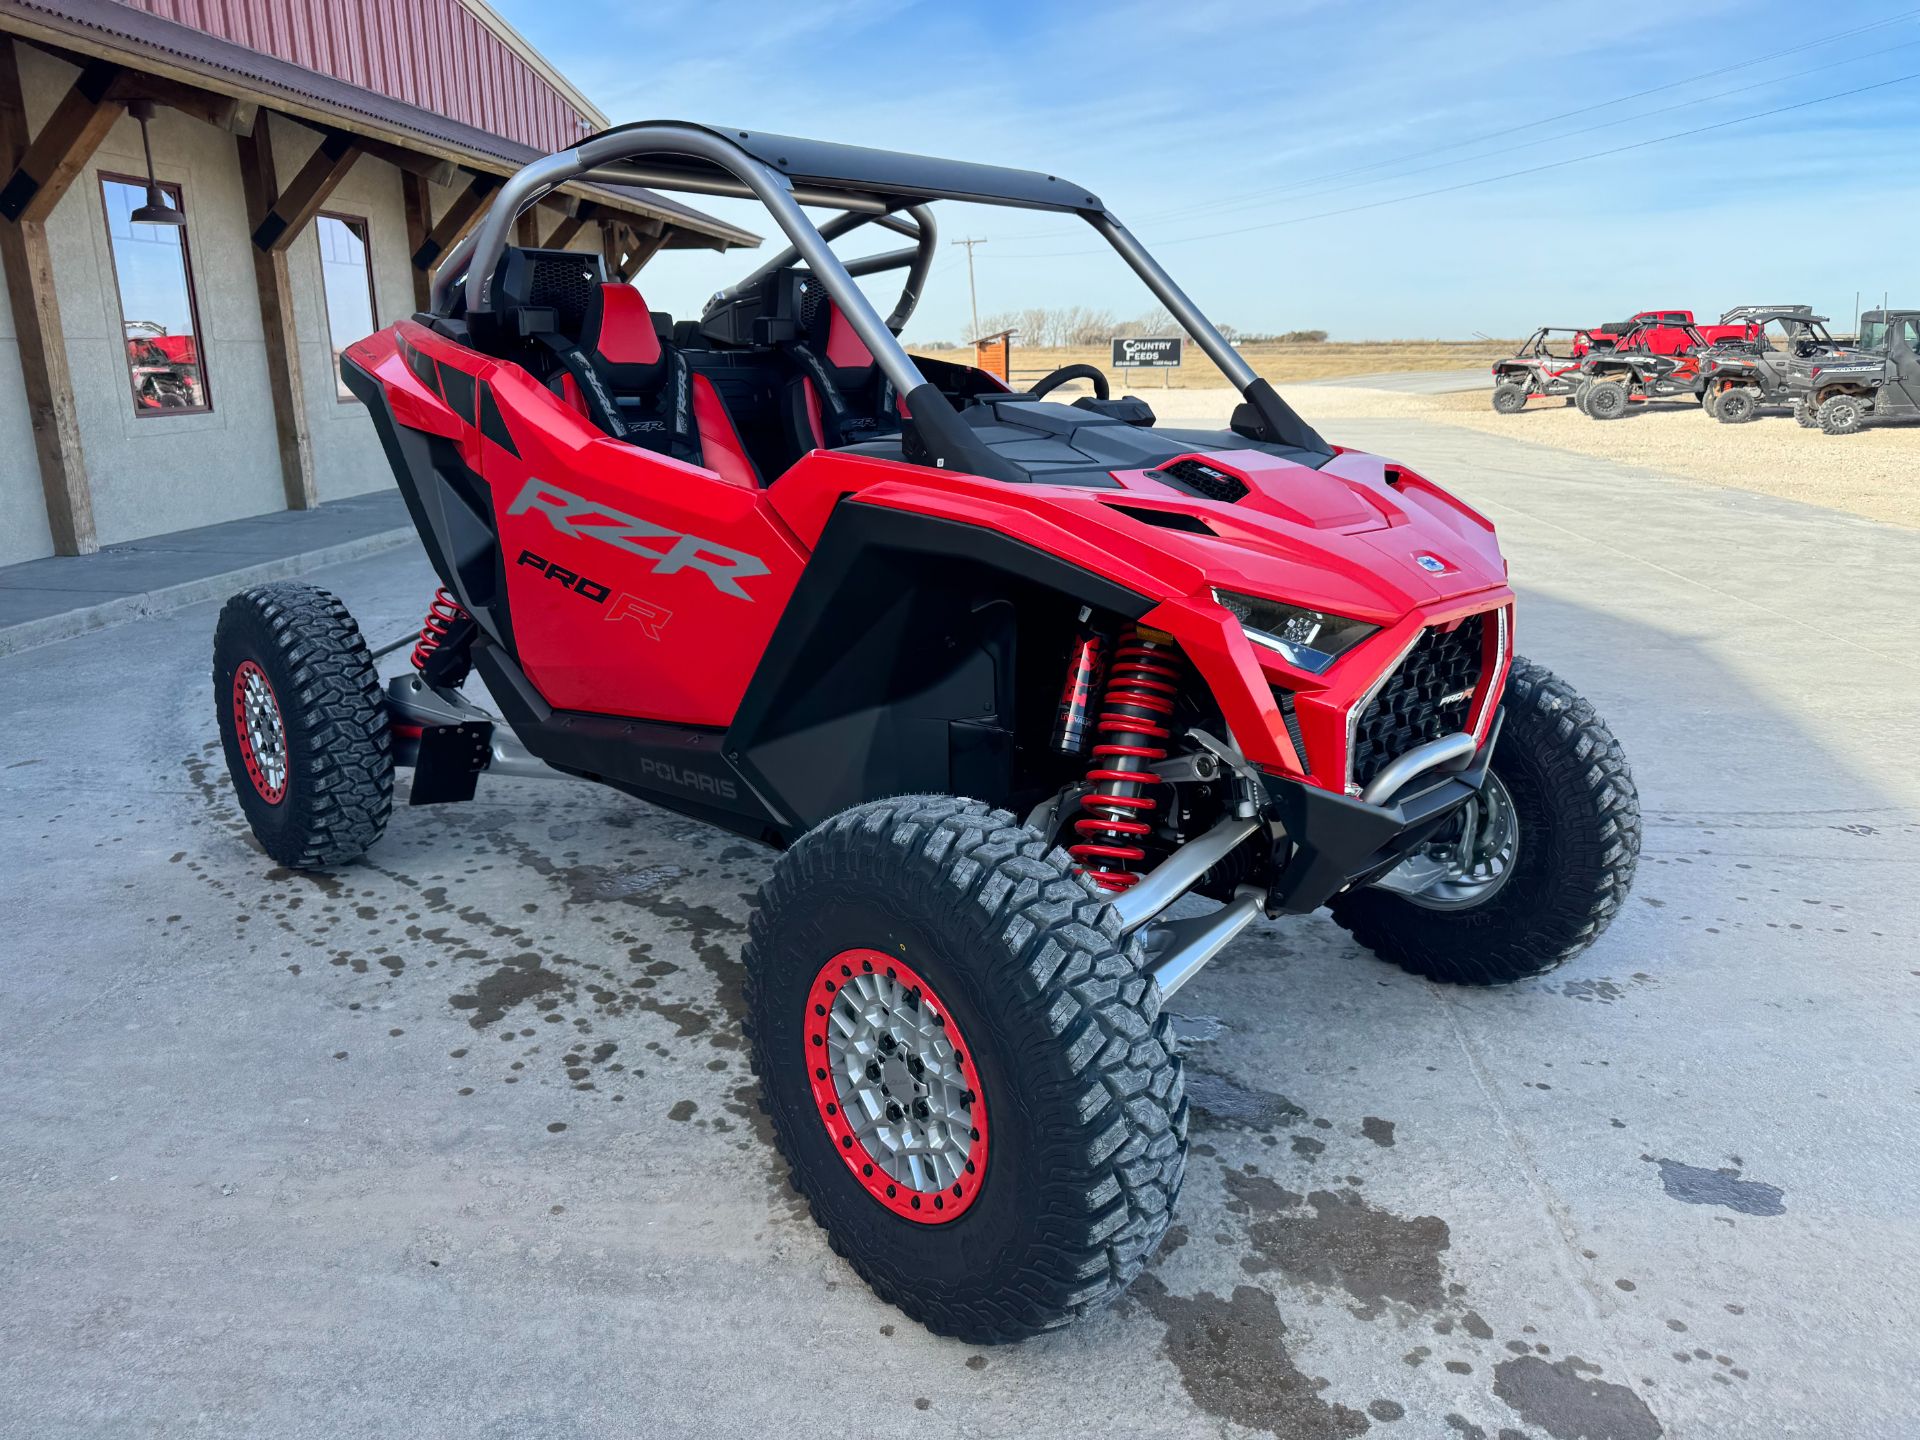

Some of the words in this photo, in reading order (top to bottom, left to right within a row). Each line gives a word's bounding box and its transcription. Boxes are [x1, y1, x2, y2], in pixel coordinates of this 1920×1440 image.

[1122, 340, 1171, 352] COUNTRY
[1126, 351, 1159, 361] FEEDS
[506, 476, 772, 603] RZR
[516, 549, 612, 604] PRO
[604, 592, 673, 641] R
[640, 757, 737, 799] POLARIS
